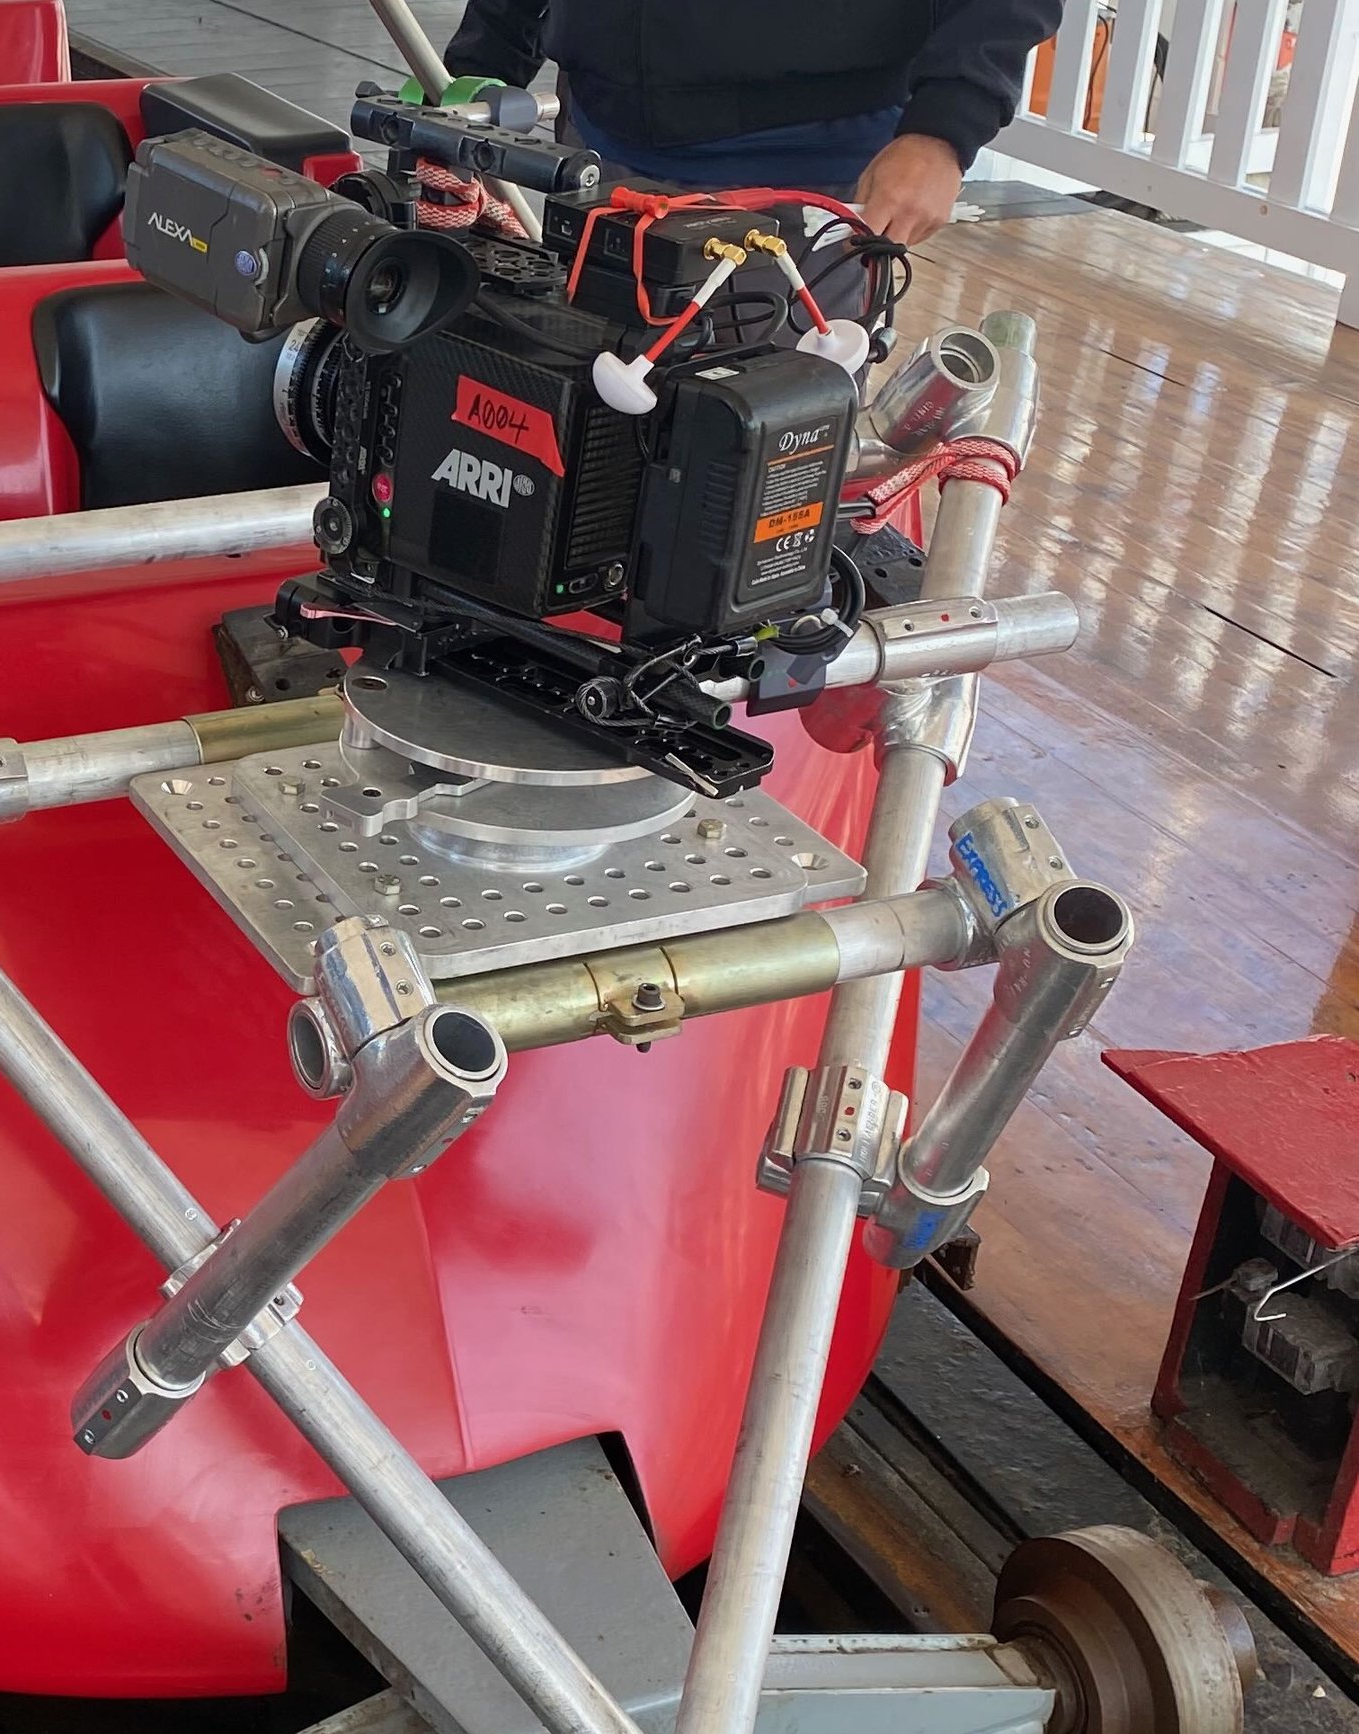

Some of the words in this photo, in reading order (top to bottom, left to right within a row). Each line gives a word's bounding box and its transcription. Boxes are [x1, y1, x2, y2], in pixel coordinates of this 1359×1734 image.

[148, 212, 193, 247] ALEXA
[467, 393, 530, 444] A004
[778, 429, 820, 455] Dyna
[431, 448, 514, 508] ARRI
